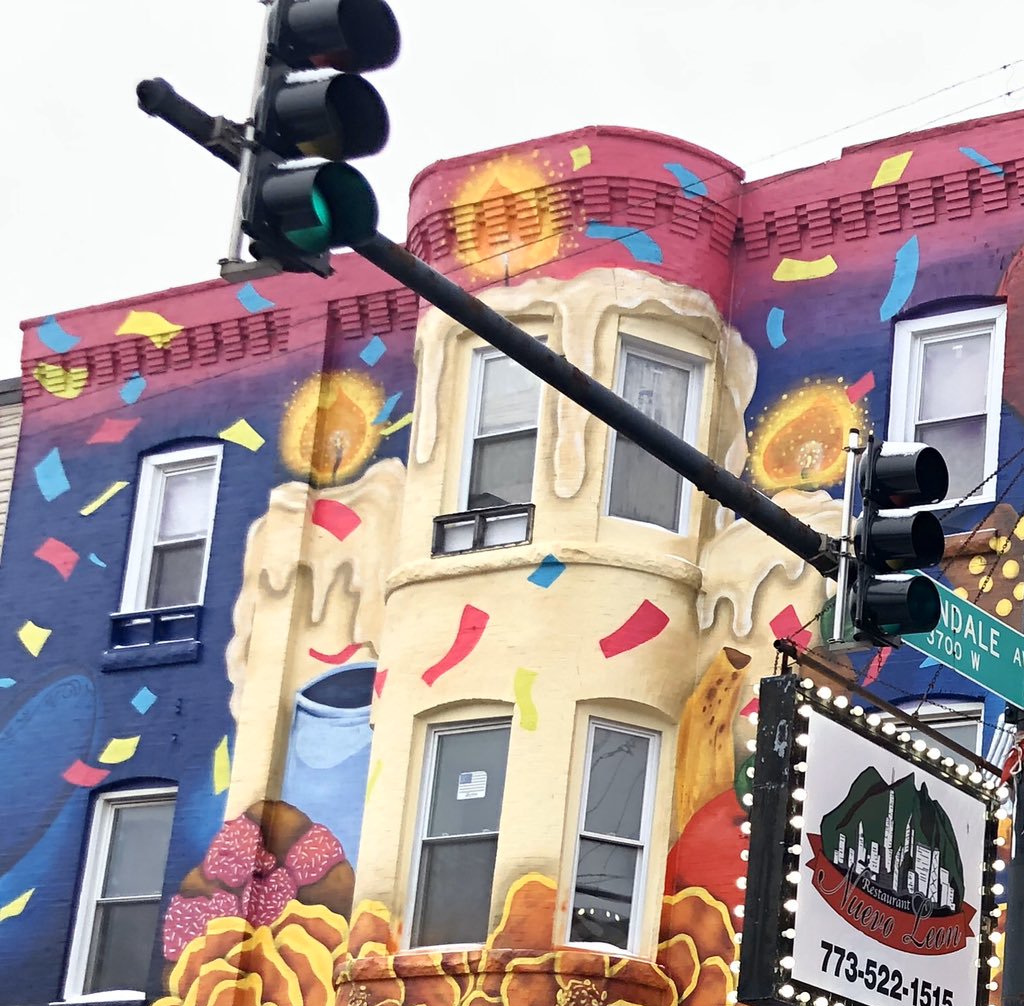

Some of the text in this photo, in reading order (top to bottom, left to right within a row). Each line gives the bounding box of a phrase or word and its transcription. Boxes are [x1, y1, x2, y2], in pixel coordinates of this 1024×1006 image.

[940, 600, 1000, 659] NDALE
[970, 650, 981, 671] W
[817, 862, 962, 949] Nuevo Leon
[861, 877, 912, 911] Restaurant
